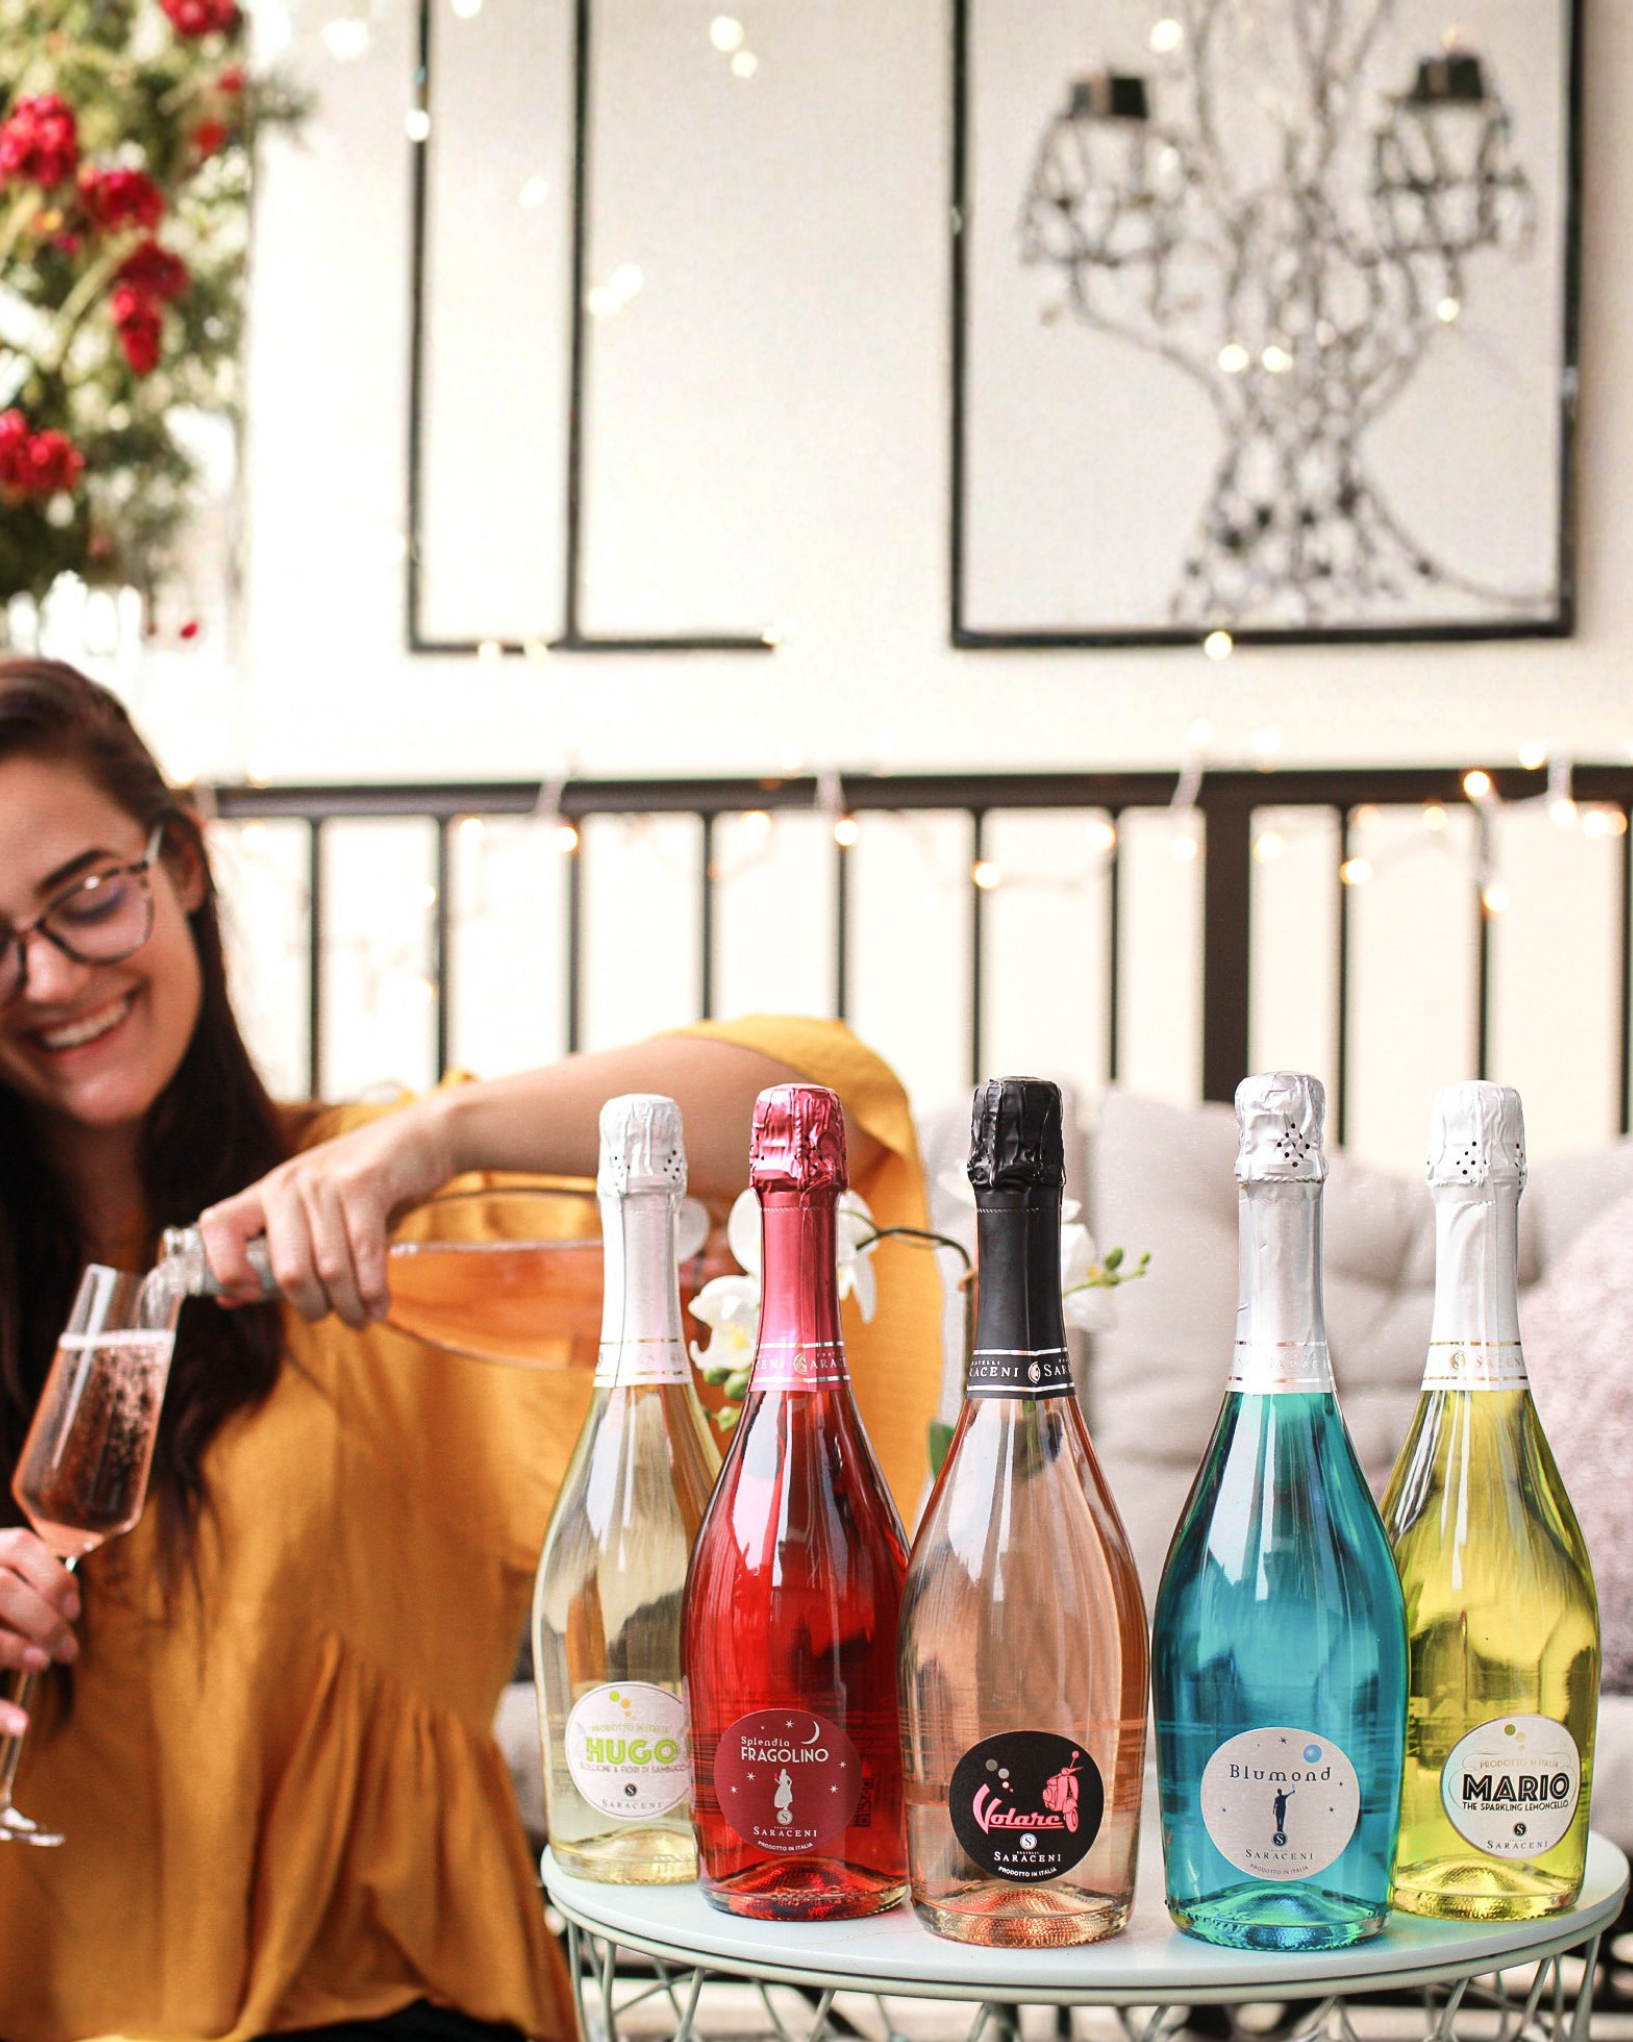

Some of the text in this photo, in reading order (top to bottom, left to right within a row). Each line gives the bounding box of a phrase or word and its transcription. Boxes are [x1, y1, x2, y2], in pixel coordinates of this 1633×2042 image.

[1044, 1363, 1070, 1378] SAR
[585, 1737, 678, 1765] HUGO
[741, 1747, 829, 1763] FRAGOLINO
[1479, 1758, 1526, 1769] PRODOTTO
[1538, 1758, 1559, 1768] ITALIA
[1229, 1764, 1331, 1782] Blumond
[1462, 1772, 1570, 1802] MARIO
[972, 1783, 1064, 1835] Volare
[1462, 1800, 1569, 1812] THE SPARKLING LEMONCELLO
[753, 1825, 818, 1838] SARACENI
[757, 1840, 787, 1852] PRODOTTO
[795, 1842, 814, 1851] ITALIA
[1486, 1839, 1549, 1850] SARACENI
[993, 1850, 1062, 1863] SARACENI
[1246, 1848, 1314, 1861] SARACENI
[997, 1865, 1030, 1877] PRODOTTO
[1038, 1866, 1057, 1877] ITALIA
[1249, 1863, 1282, 1875] PRODOTTO
[1291, 1865, 1309, 1875] ITALIA
